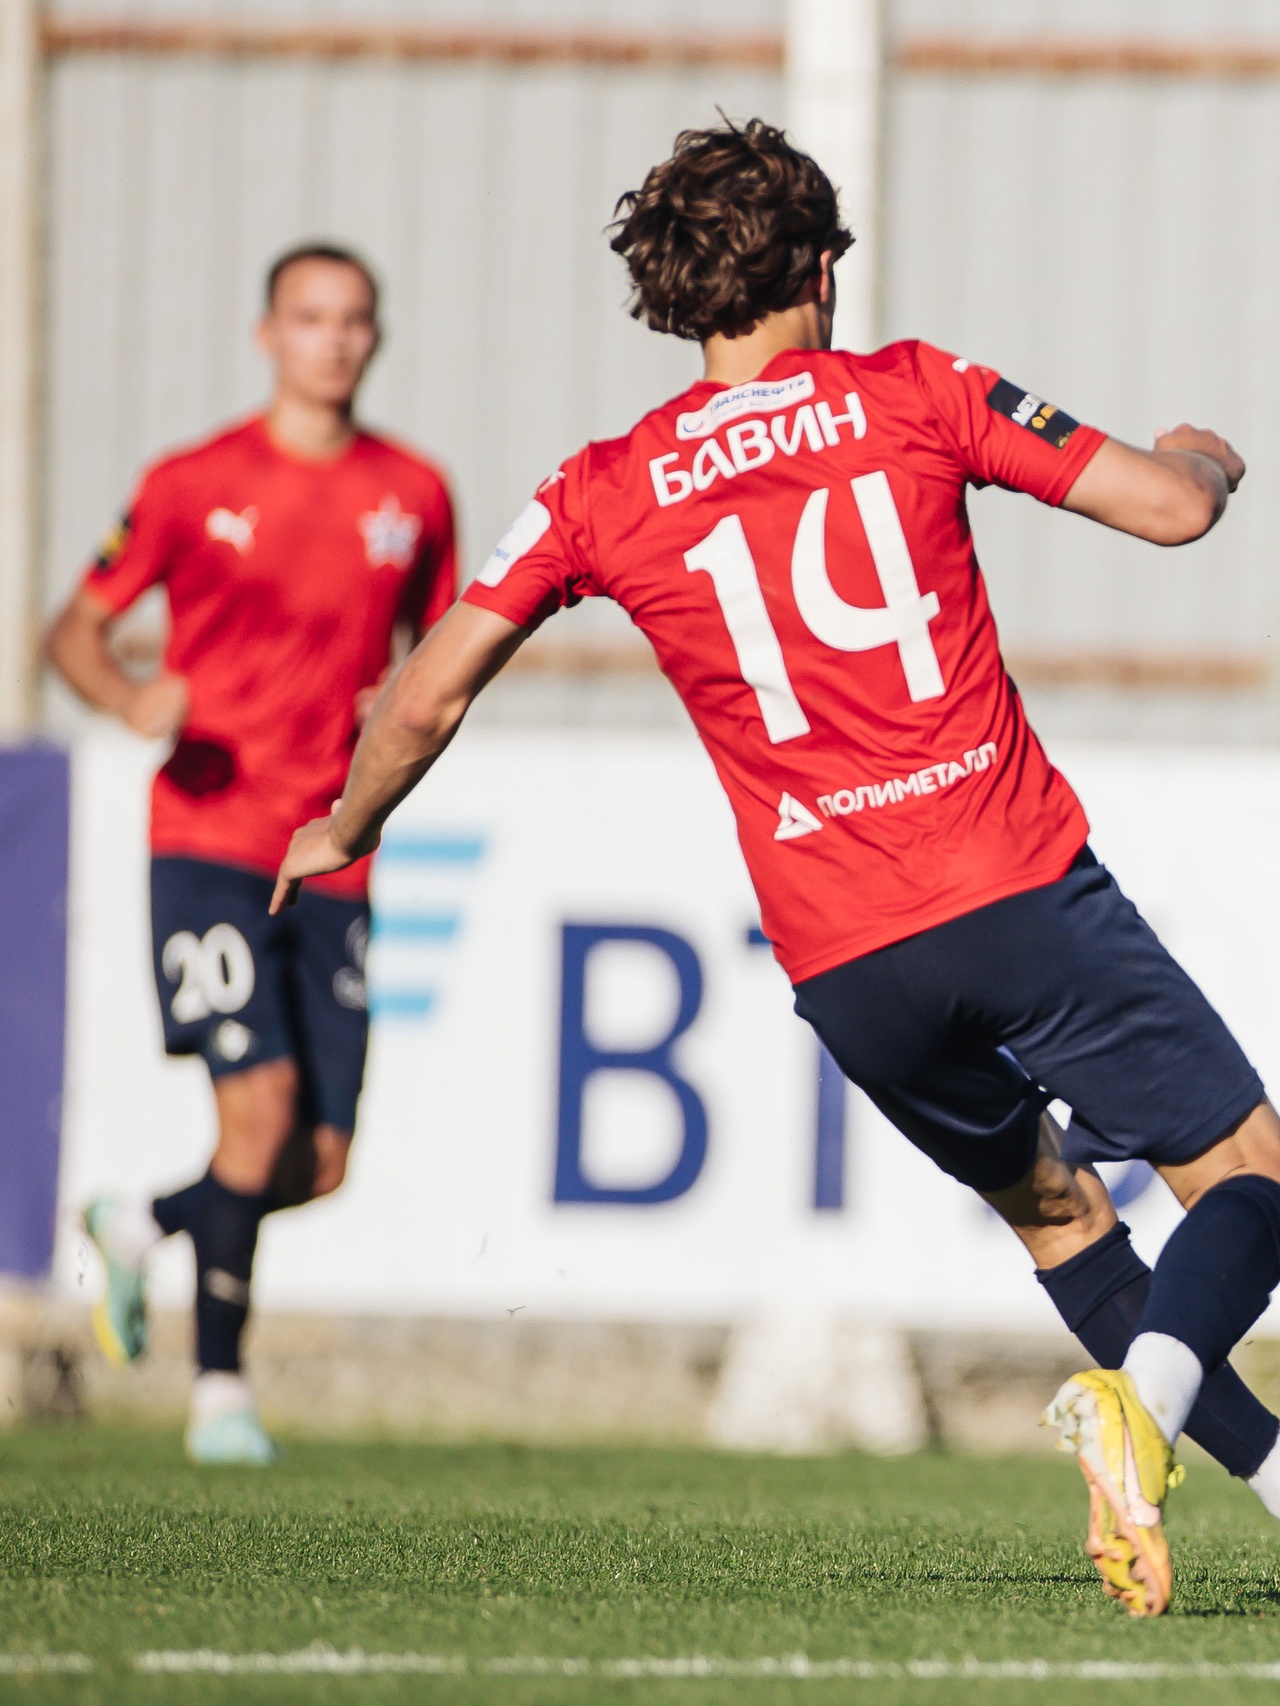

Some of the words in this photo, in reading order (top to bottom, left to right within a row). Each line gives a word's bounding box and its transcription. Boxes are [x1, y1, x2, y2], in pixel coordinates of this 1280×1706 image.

[649, 392, 867, 507] БАВИН
[683, 470, 946, 745] 14
[816, 740, 999, 819] ПОЛИМЕТАЛЛ
[161, 921, 256, 1026] 20
